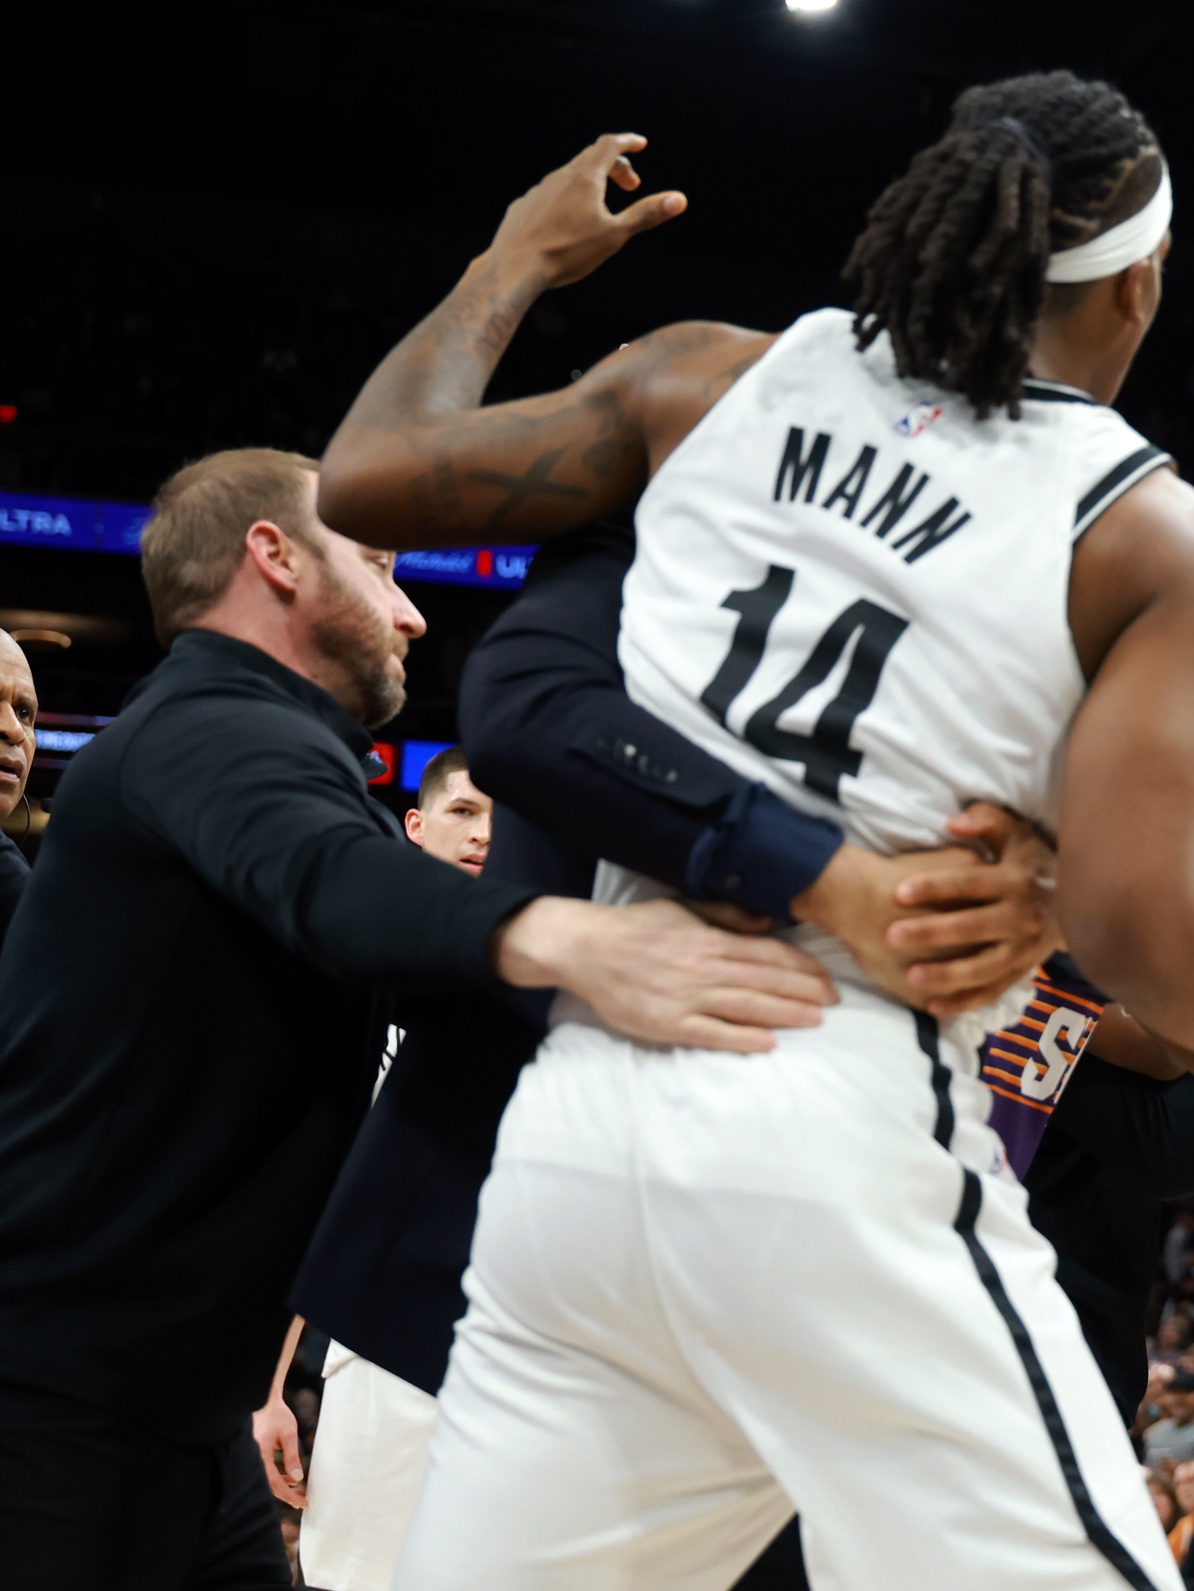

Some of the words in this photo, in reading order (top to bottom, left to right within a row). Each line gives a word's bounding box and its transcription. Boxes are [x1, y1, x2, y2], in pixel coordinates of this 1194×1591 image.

[0, 508, 72, 537] LTRA
[773, 426, 972, 564] MANN
[700, 563, 910, 803] 14
